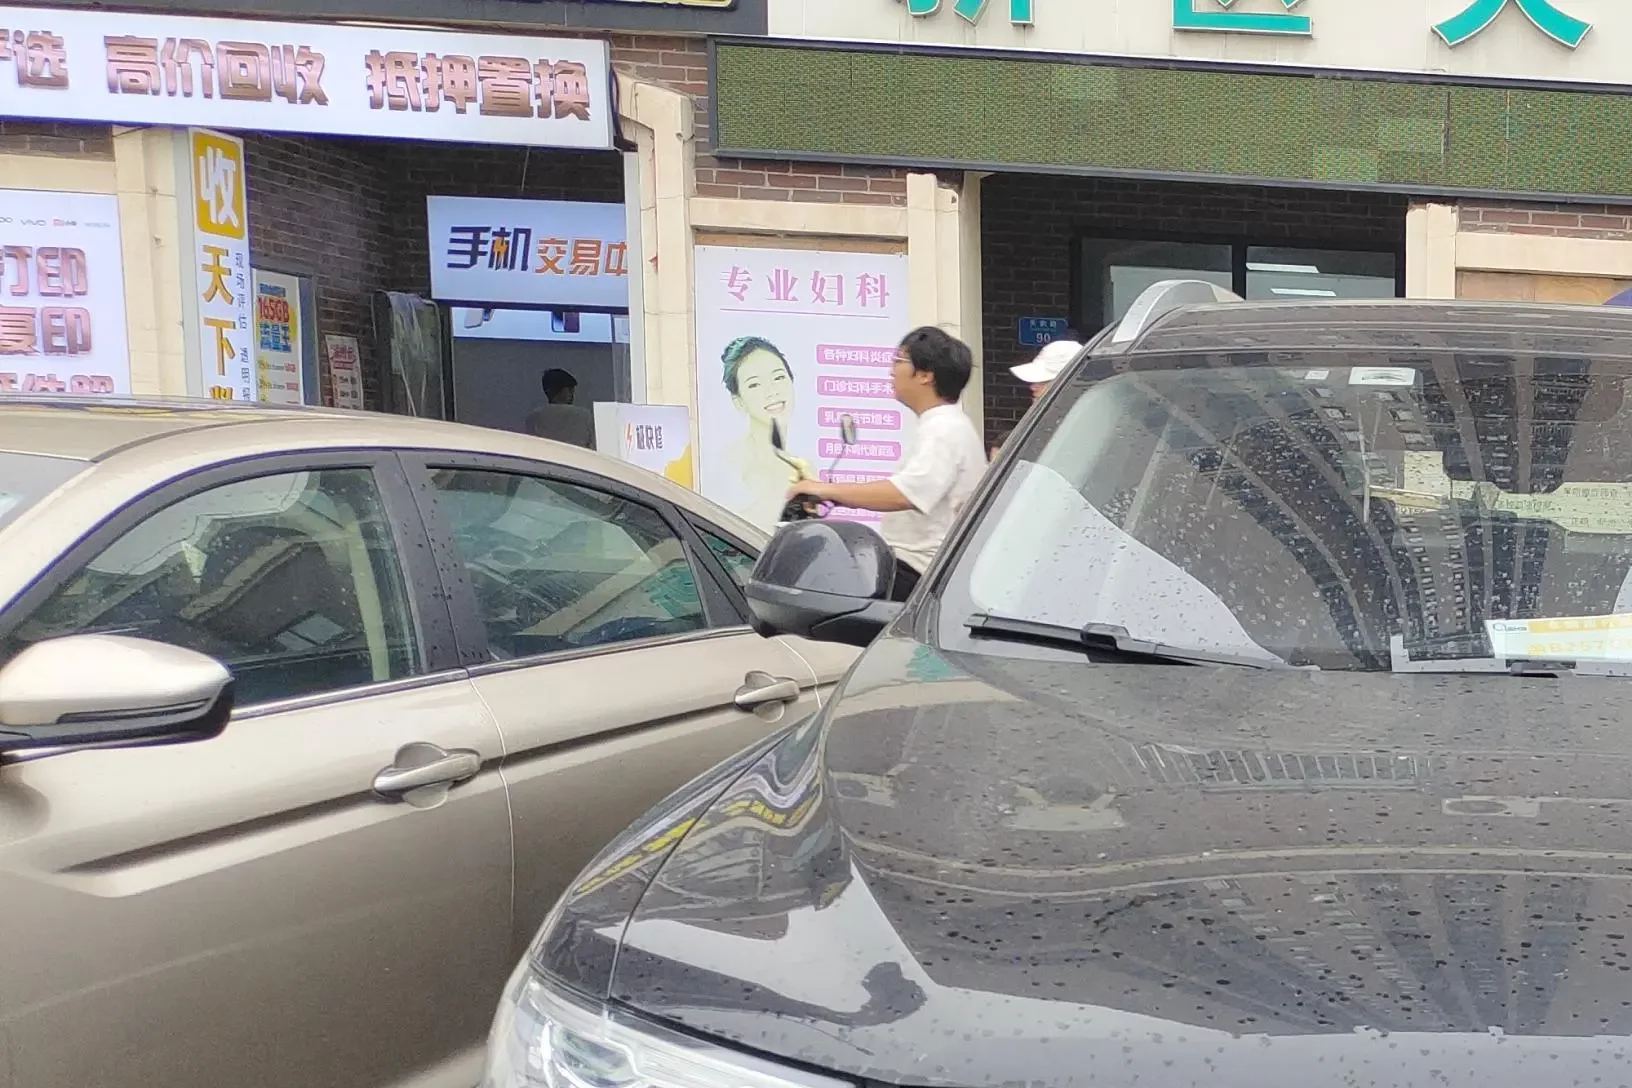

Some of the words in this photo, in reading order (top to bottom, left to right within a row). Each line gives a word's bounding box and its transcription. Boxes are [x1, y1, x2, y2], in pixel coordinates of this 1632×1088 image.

[0, 28, 69, 89] 选
[104, 35, 329, 106] 高价回收
[365, 49, 591, 121] 抵押置换
[719, 265, 890, 309] 专业妇科
